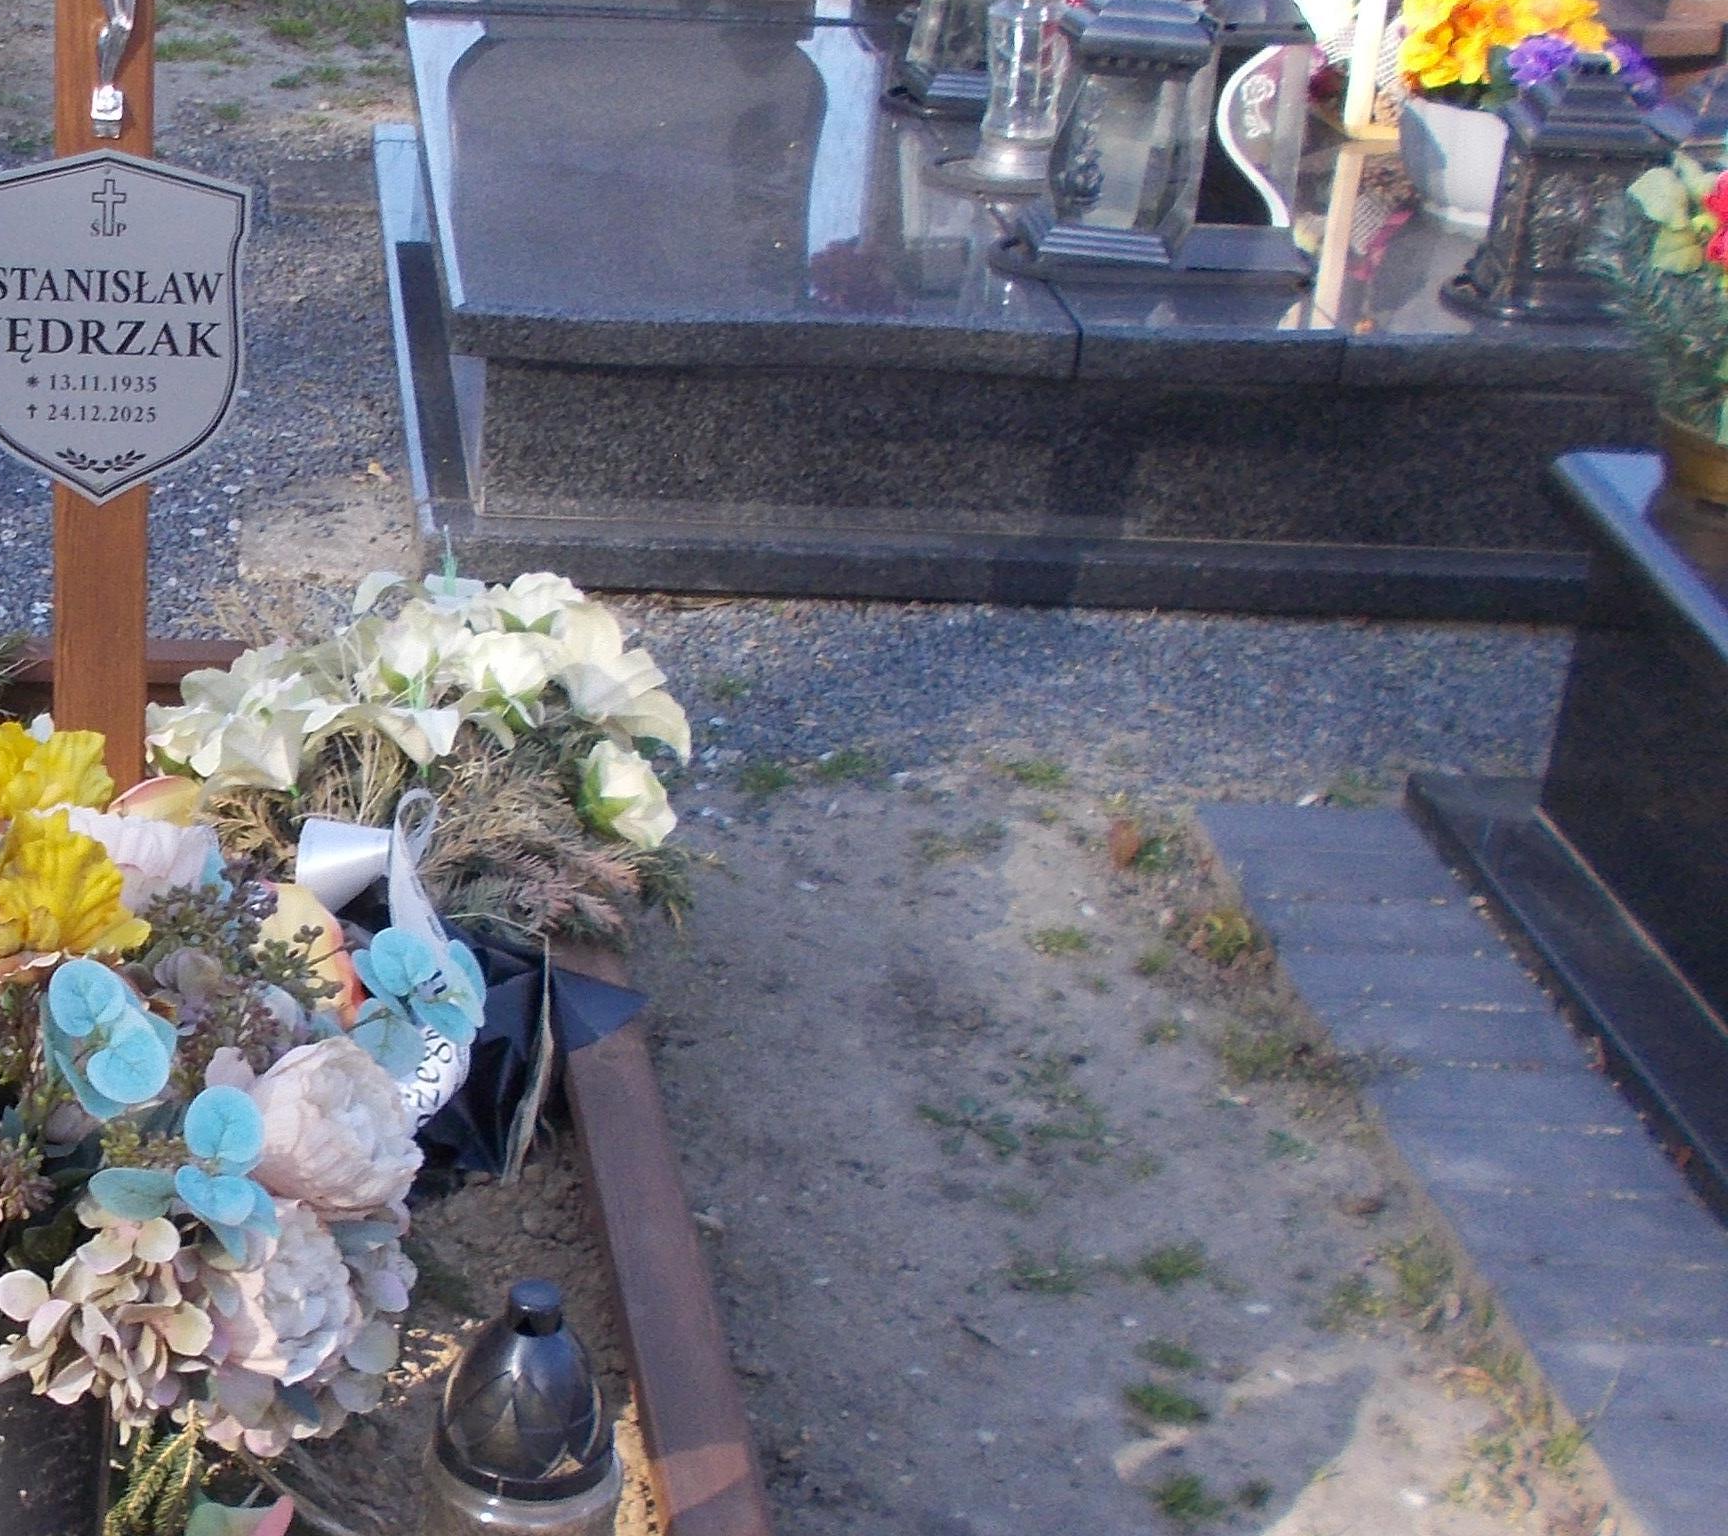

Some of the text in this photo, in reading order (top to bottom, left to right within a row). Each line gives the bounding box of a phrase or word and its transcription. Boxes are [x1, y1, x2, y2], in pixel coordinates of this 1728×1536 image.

[115, 221, 127, 237] P
[48, 373, 158, 394] 13.11.1935
[46, 403, 158, 424] 24.12.2025
